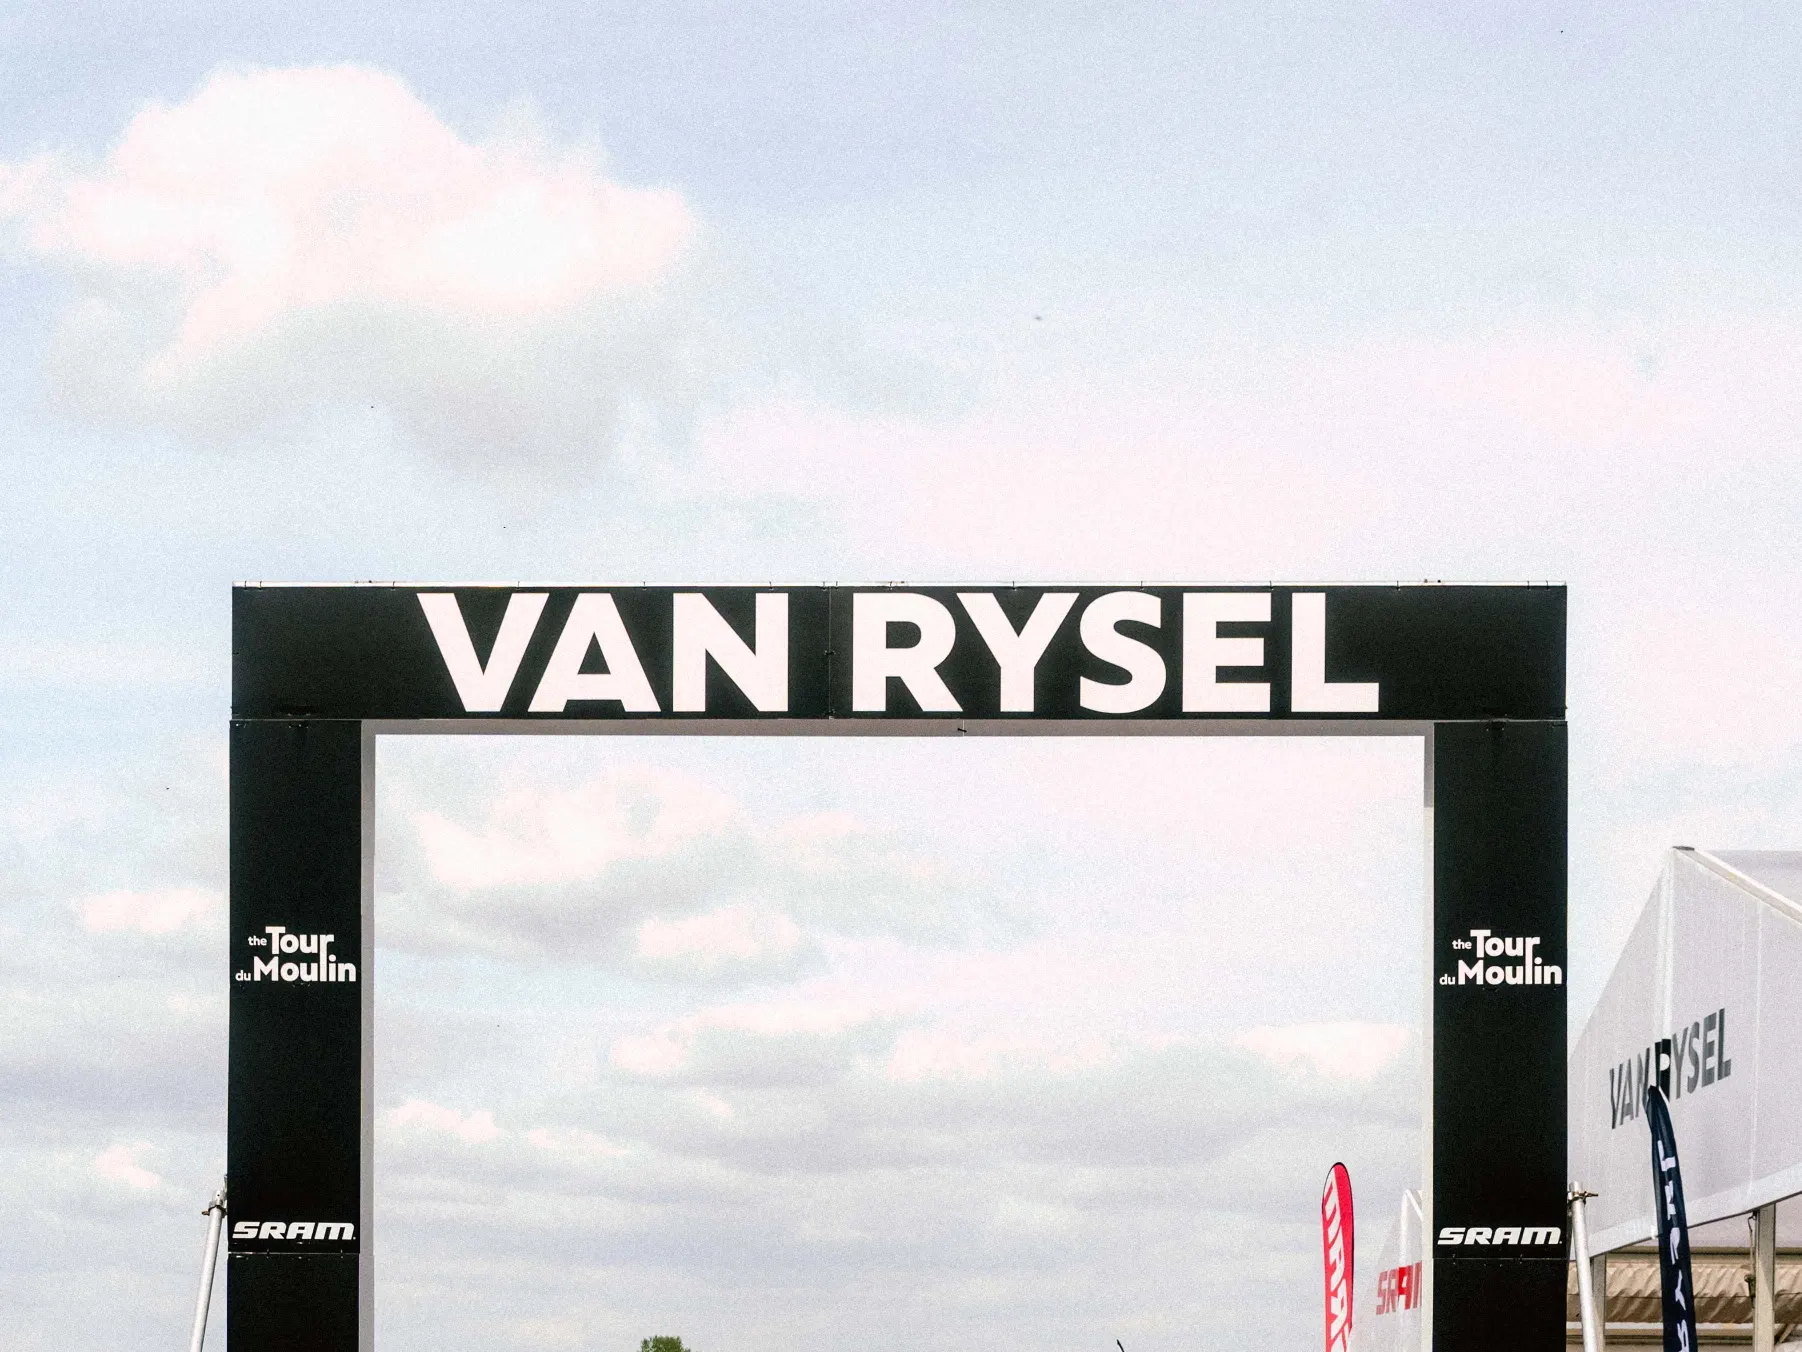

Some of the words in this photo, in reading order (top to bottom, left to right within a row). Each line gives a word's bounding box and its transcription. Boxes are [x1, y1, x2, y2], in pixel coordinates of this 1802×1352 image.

[416, 592, 789, 712] VAN
[852, 590, 1380, 713] RYSEL
[248, 936, 268, 946] the
[265, 926, 335, 955] Tour
[1452, 939, 1472, 949] the
[1470, 929, 1540, 958] Tour
[235, 970, 251, 981] du
[253, 954, 356, 982] Moulin
[1439, 974, 1456, 985] du
[1458, 957, 1562, 985] Moulin
[232, 1221, 356, 1240] SRAM
[1437, 1227, 1562, 1245] SRAM
